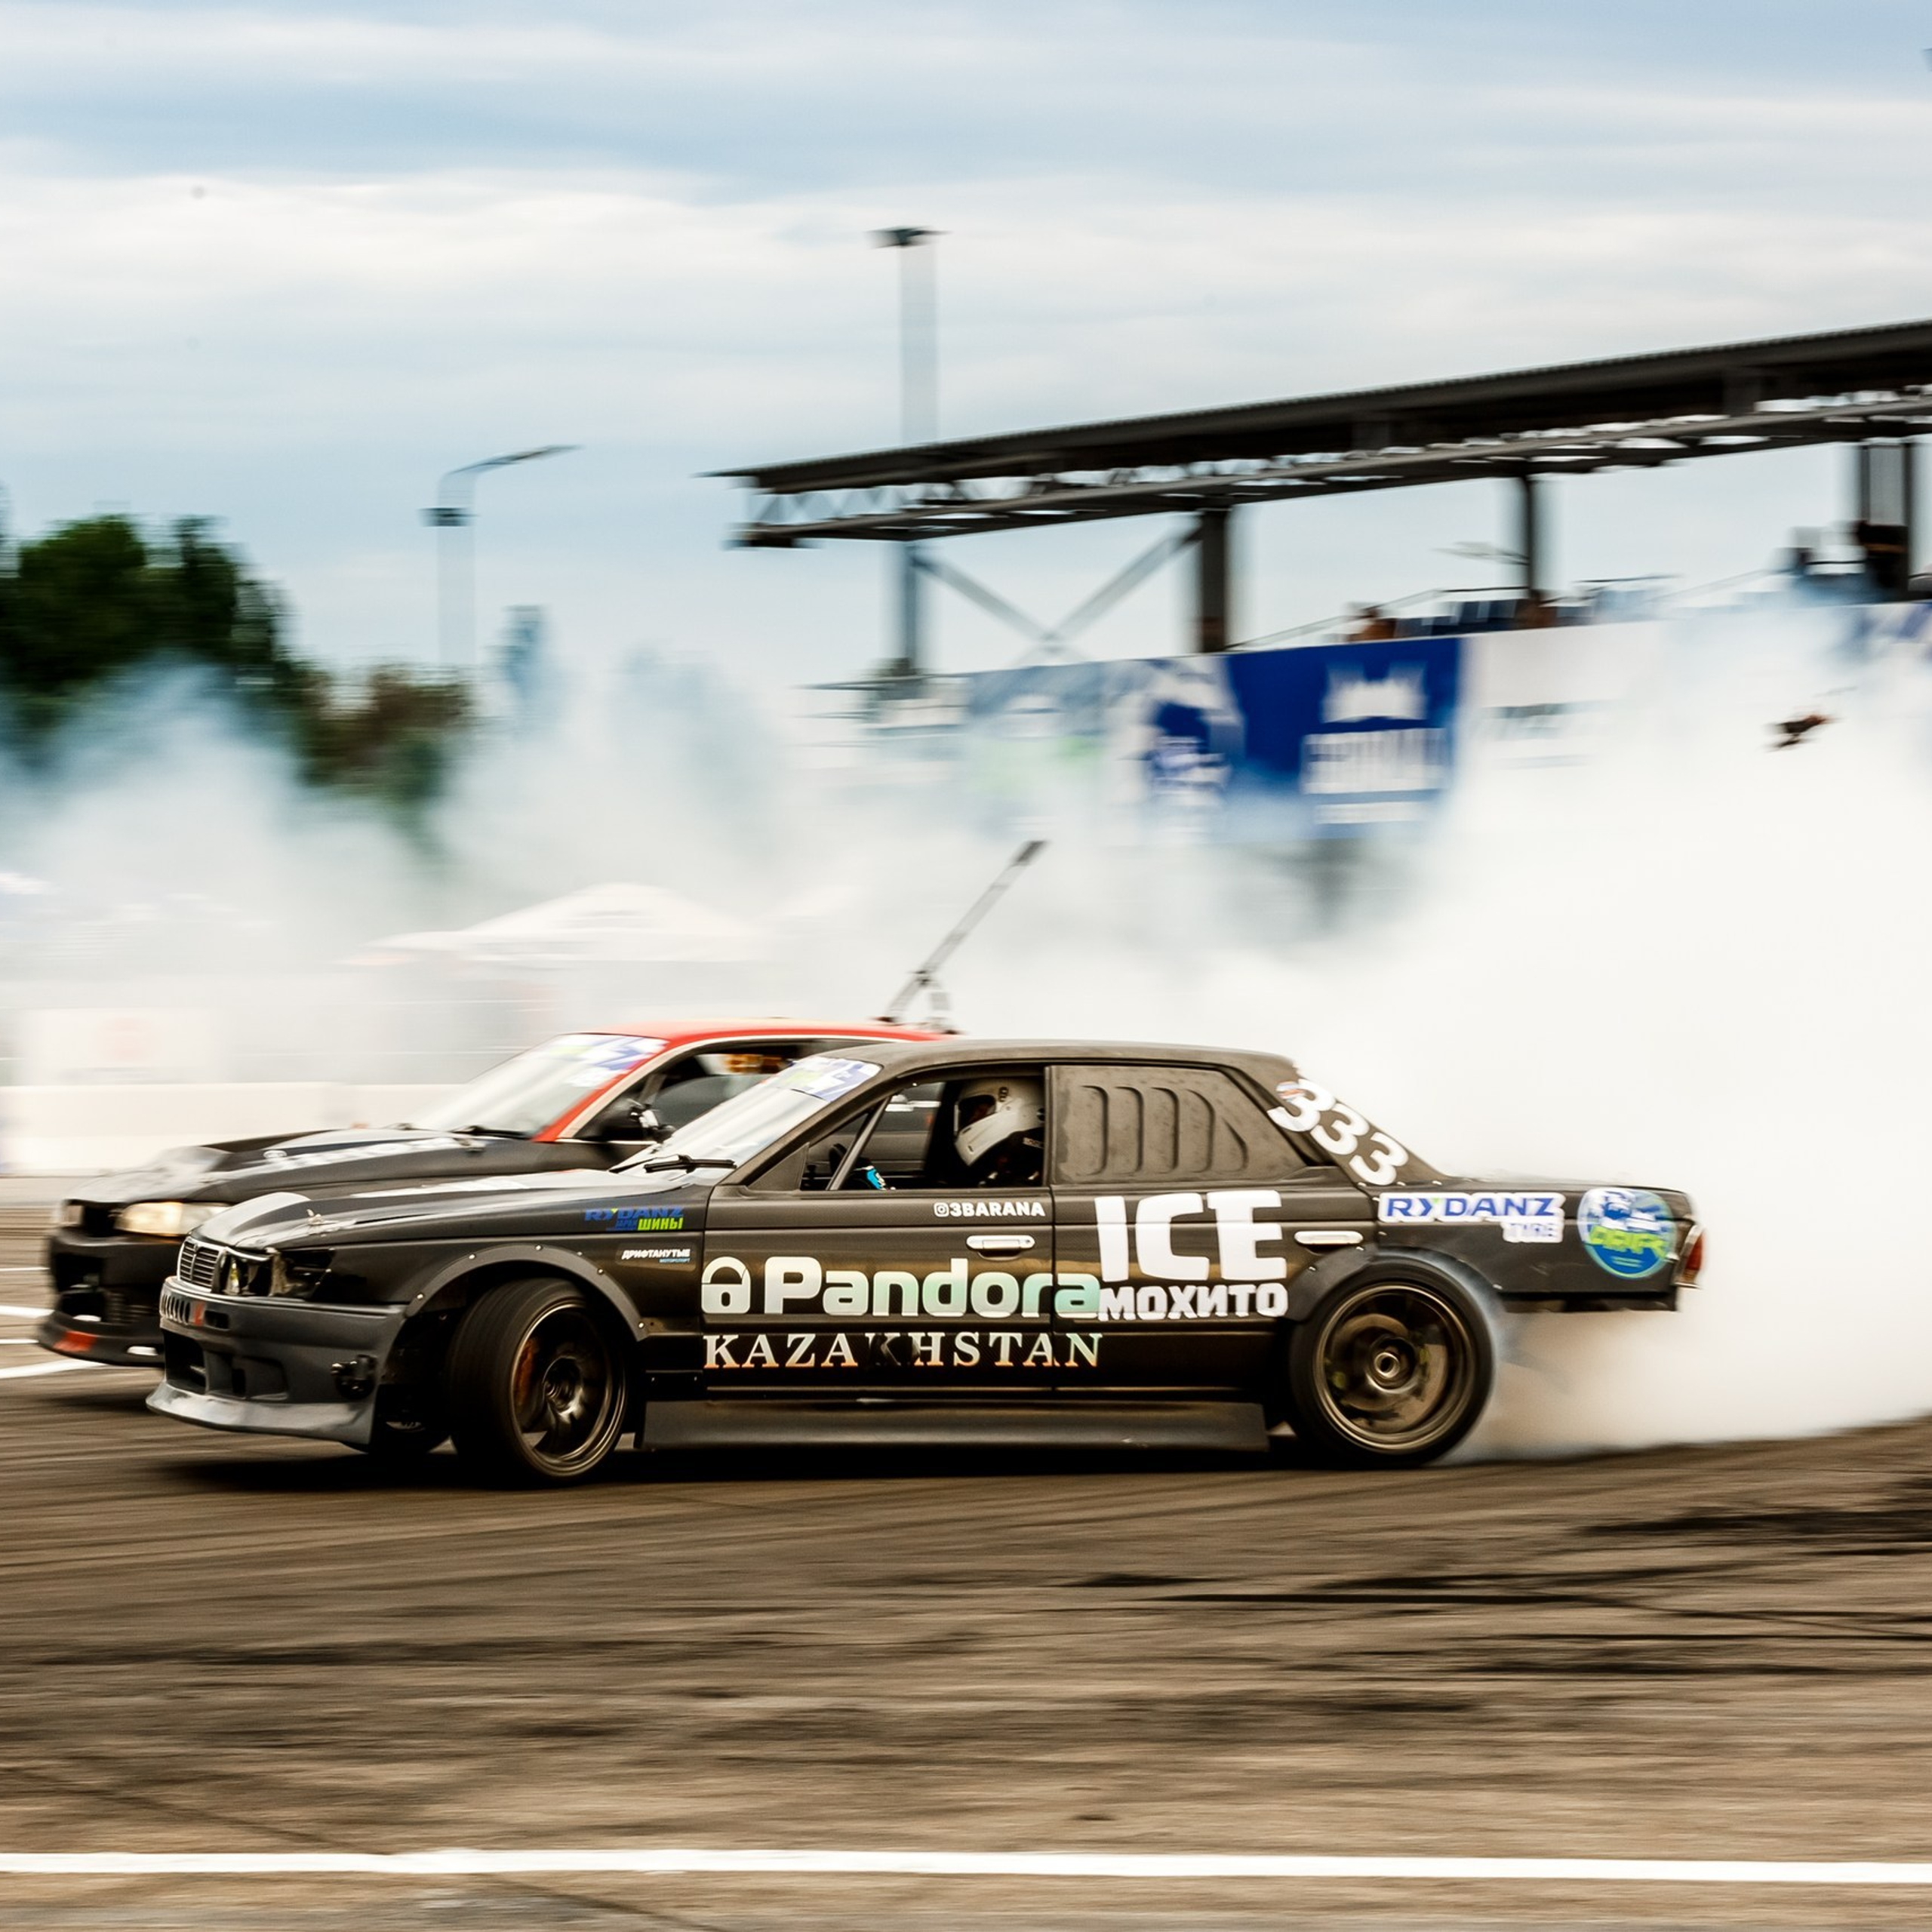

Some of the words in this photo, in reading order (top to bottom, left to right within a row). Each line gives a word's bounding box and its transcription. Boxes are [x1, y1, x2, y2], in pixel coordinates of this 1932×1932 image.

[1266, 1078, 1409, 1186] 333
[584, 1205, 684, 1221] RYDANZ
[637, 1217, 684, 1231] ШИНЫ
[1386, 1196, 1557, 1218] RYDANZ
[1094, 1189, 1287, 1282] ICE
[764, 1257, 1101, 1319] Pandora
[1097, 1283, 1288, 1321] МОХИТО
